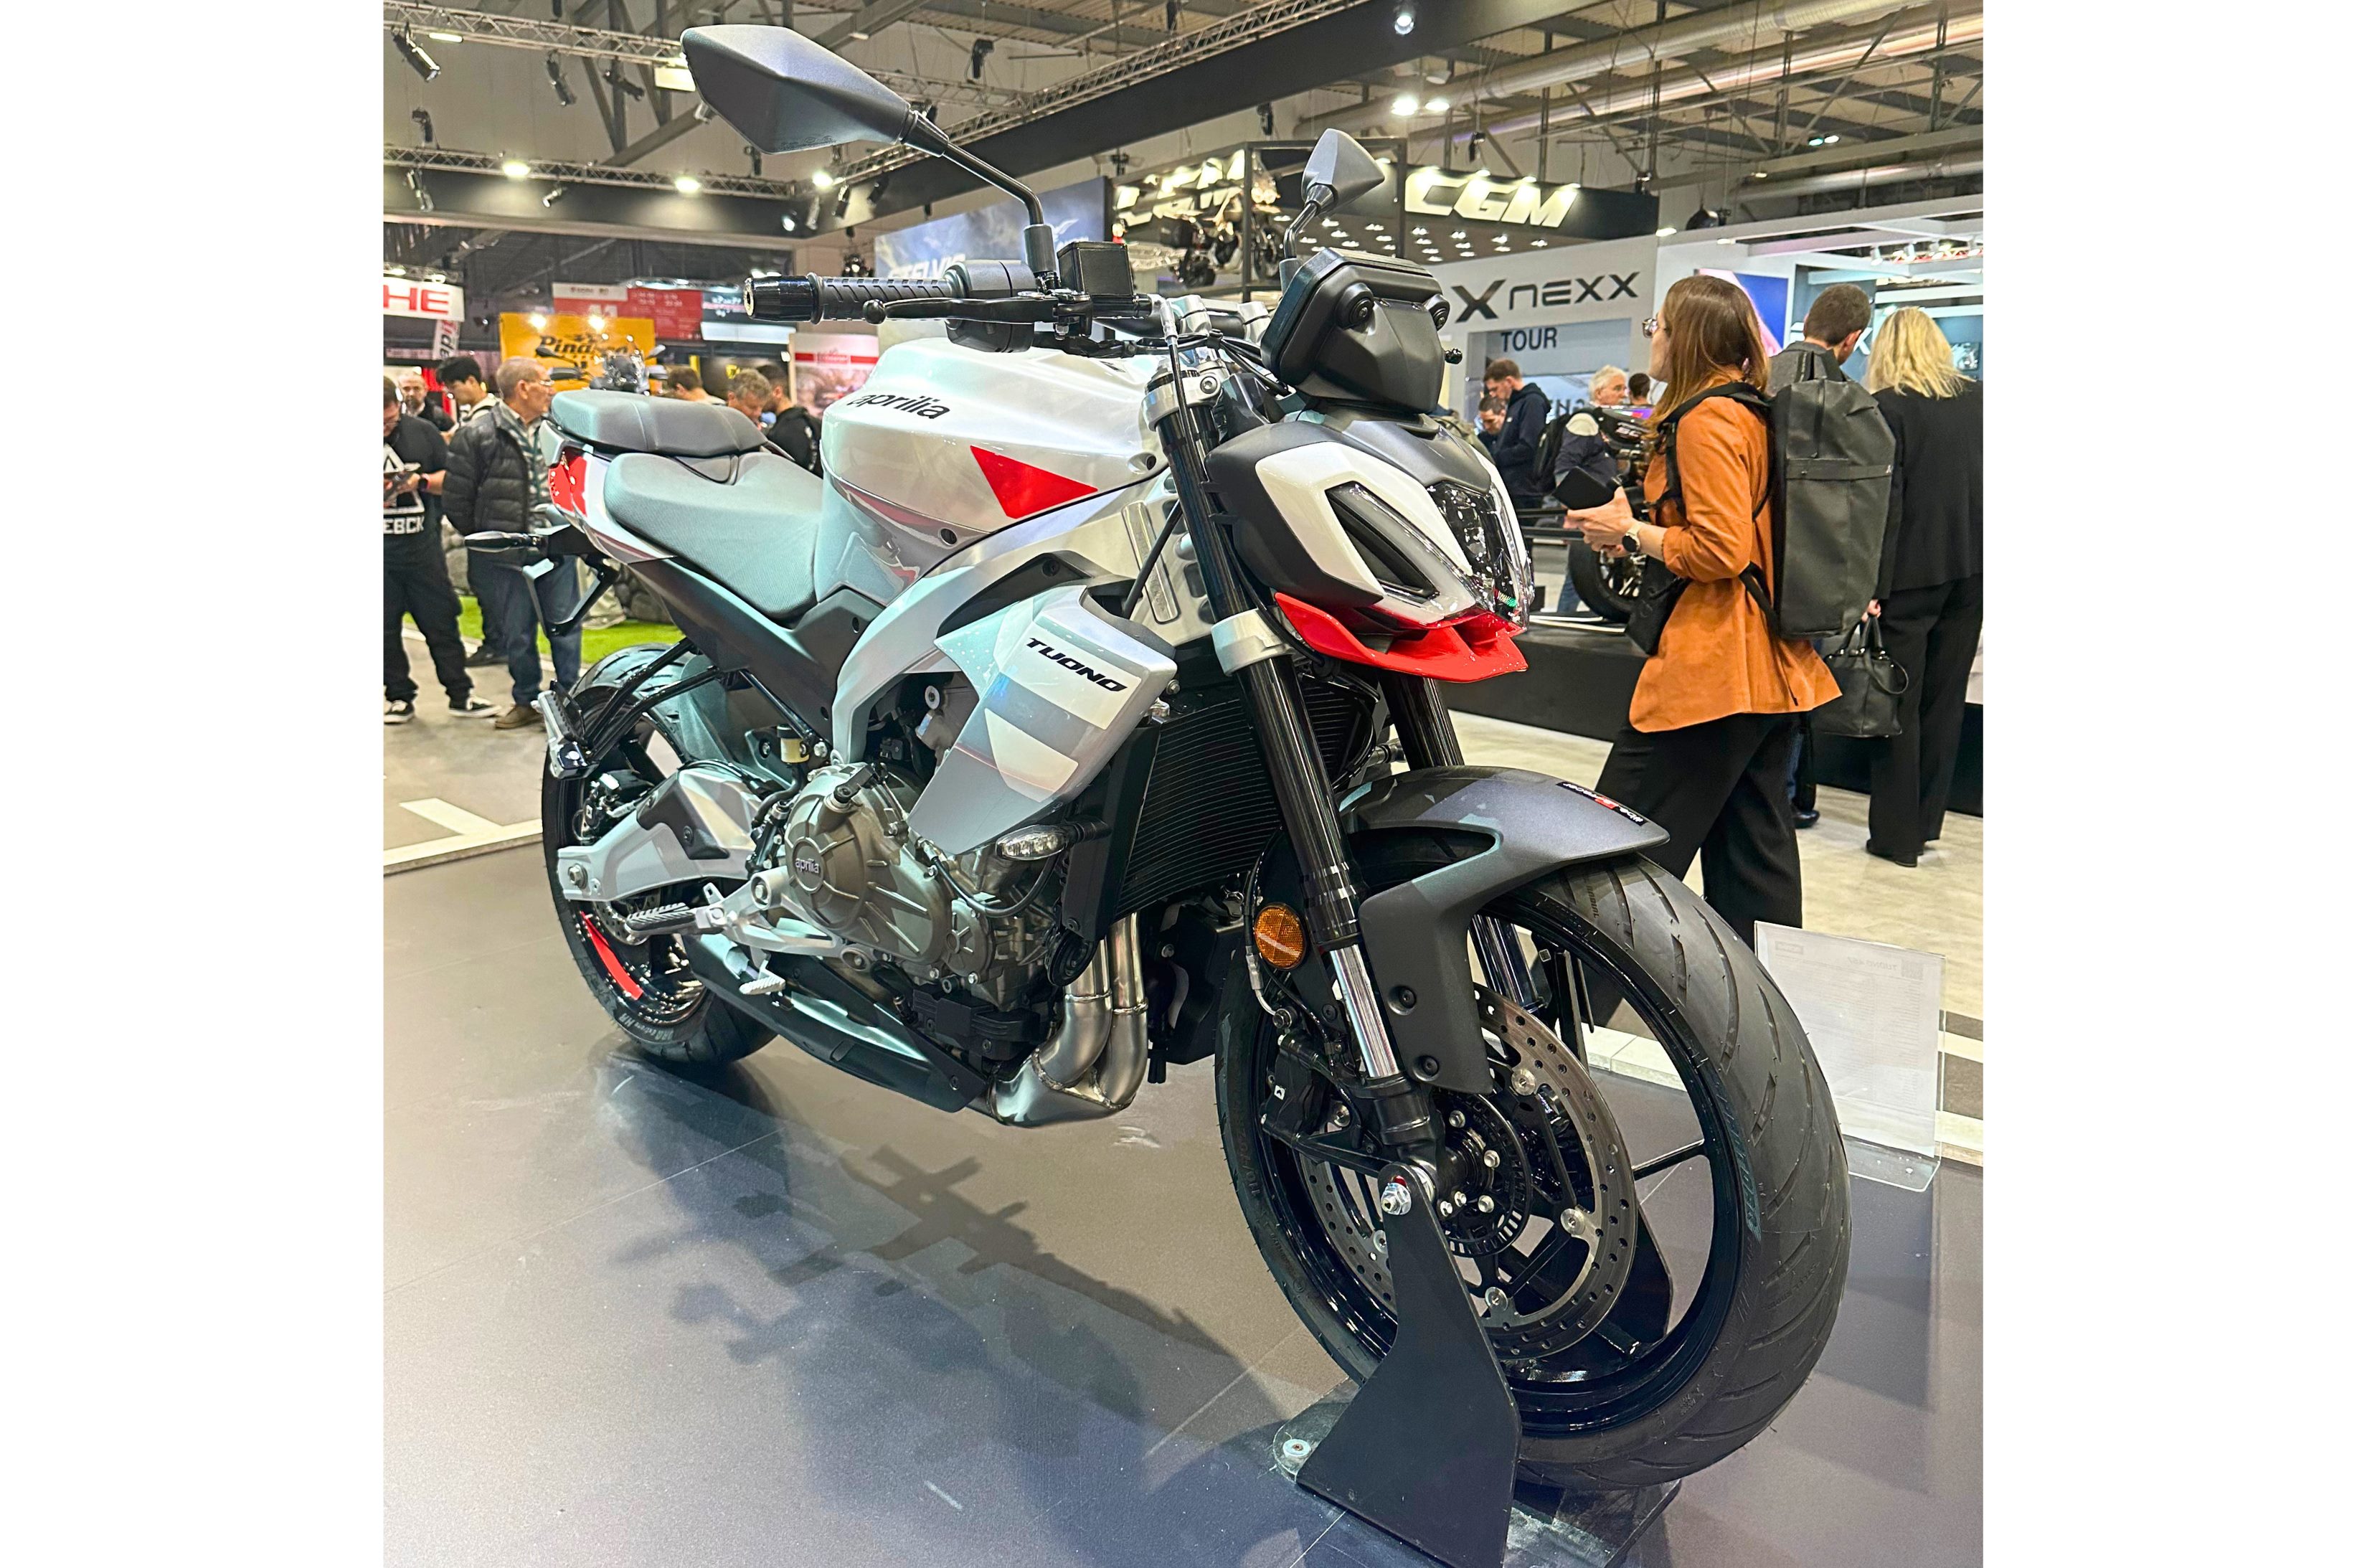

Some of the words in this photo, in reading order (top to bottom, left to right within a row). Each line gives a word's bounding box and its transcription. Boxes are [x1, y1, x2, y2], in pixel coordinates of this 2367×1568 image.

[1404, 171, 1578, 228] CGM
[384, 285, 449, 314] HE
[1501, 327, 1557, 351] TOUR
[847, 395, 950, 420] aprilia
[1026, 637, 1128, 692] TUONO
[795, 858, 819, 874] aprilia
